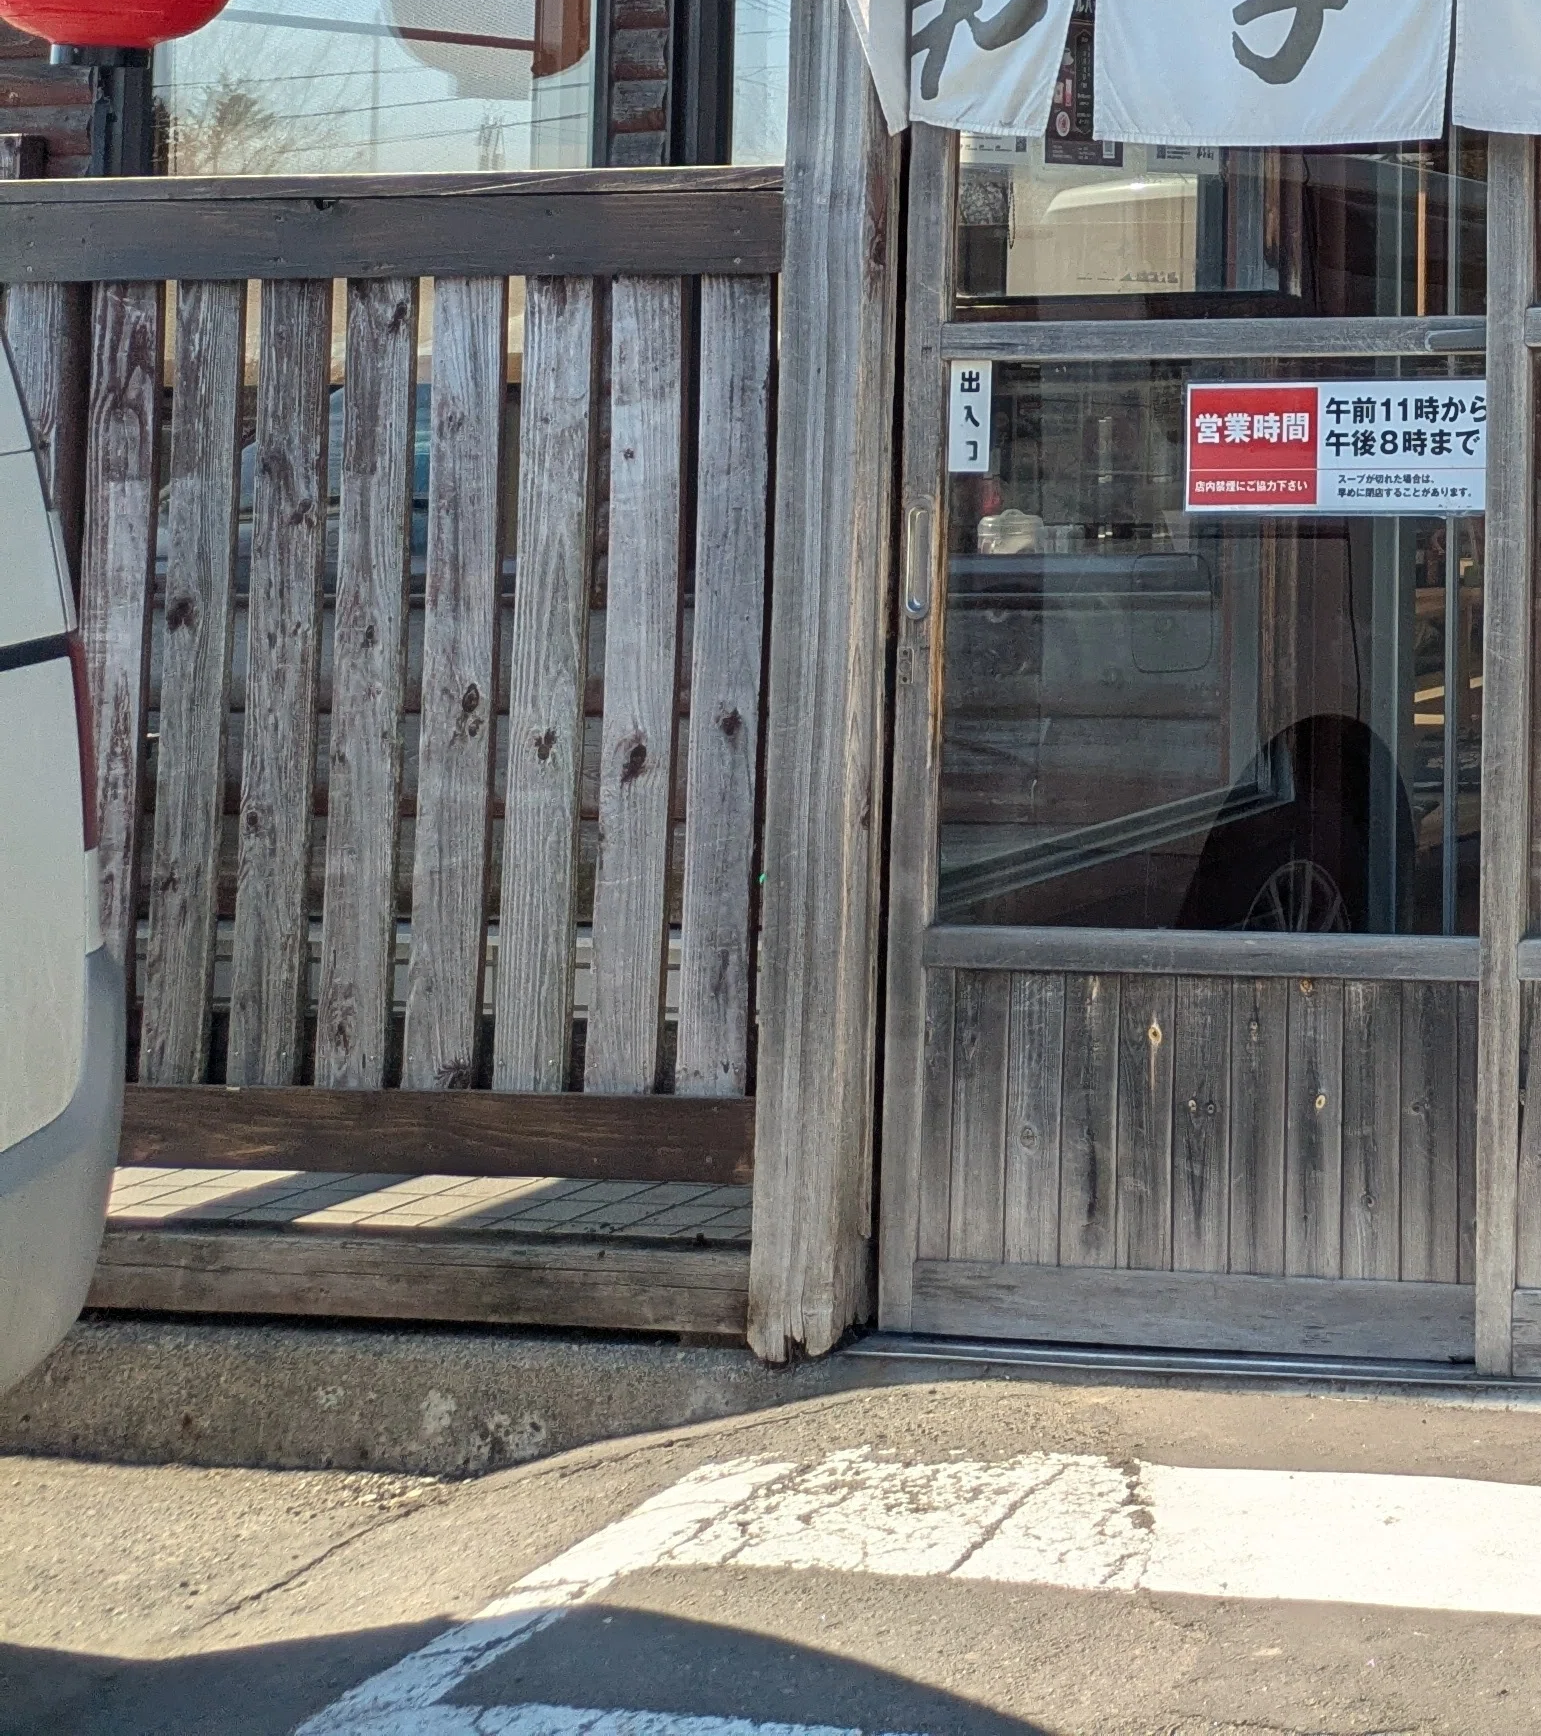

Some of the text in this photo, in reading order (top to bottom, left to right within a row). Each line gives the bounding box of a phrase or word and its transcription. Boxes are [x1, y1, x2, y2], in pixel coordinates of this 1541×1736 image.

[960, 370, 980, 462] 出入口
[1325, 396, 1487, 425] 午前11時から
[1195, 412, 1310, 444] 営業時間
[1325, 429, 1481, 457] 午後8時まで
[1194, 480, 1308, 493] 店内禁煙にご協力下さい
